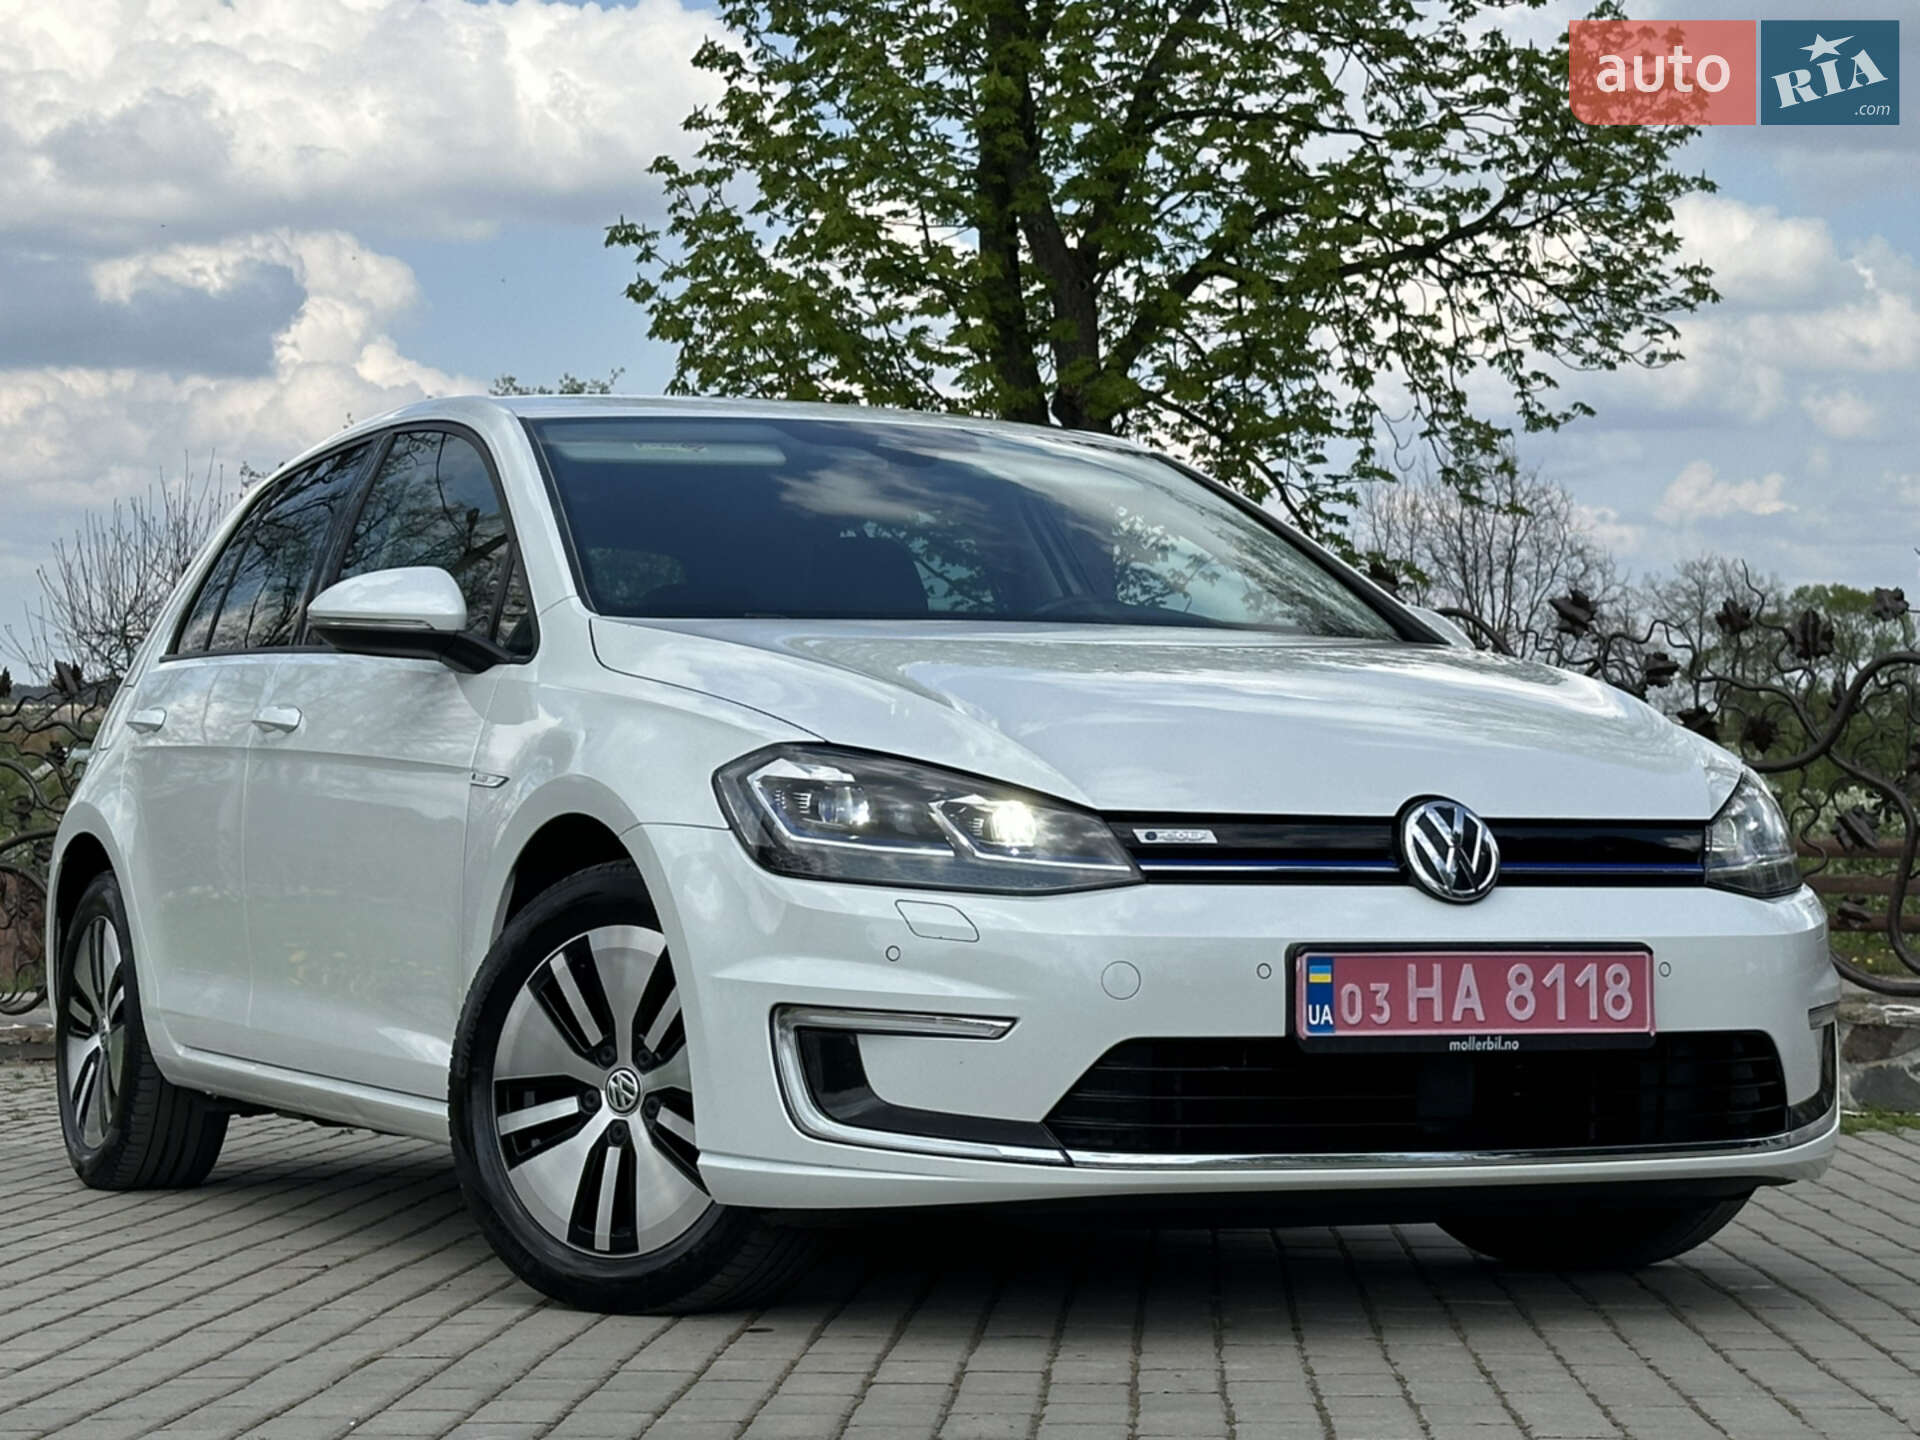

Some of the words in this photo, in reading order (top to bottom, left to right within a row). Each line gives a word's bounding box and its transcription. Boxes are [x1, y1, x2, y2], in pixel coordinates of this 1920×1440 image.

[1340, 983, 1391, 1025] 03
[1407, 963, 1485, 1023] HA
[1505, 963, 1633, 1022] 8118
[1308, 1004, 1334, 1026] UA
[1449, 1035, 1520, 1051] mollerbil.no
